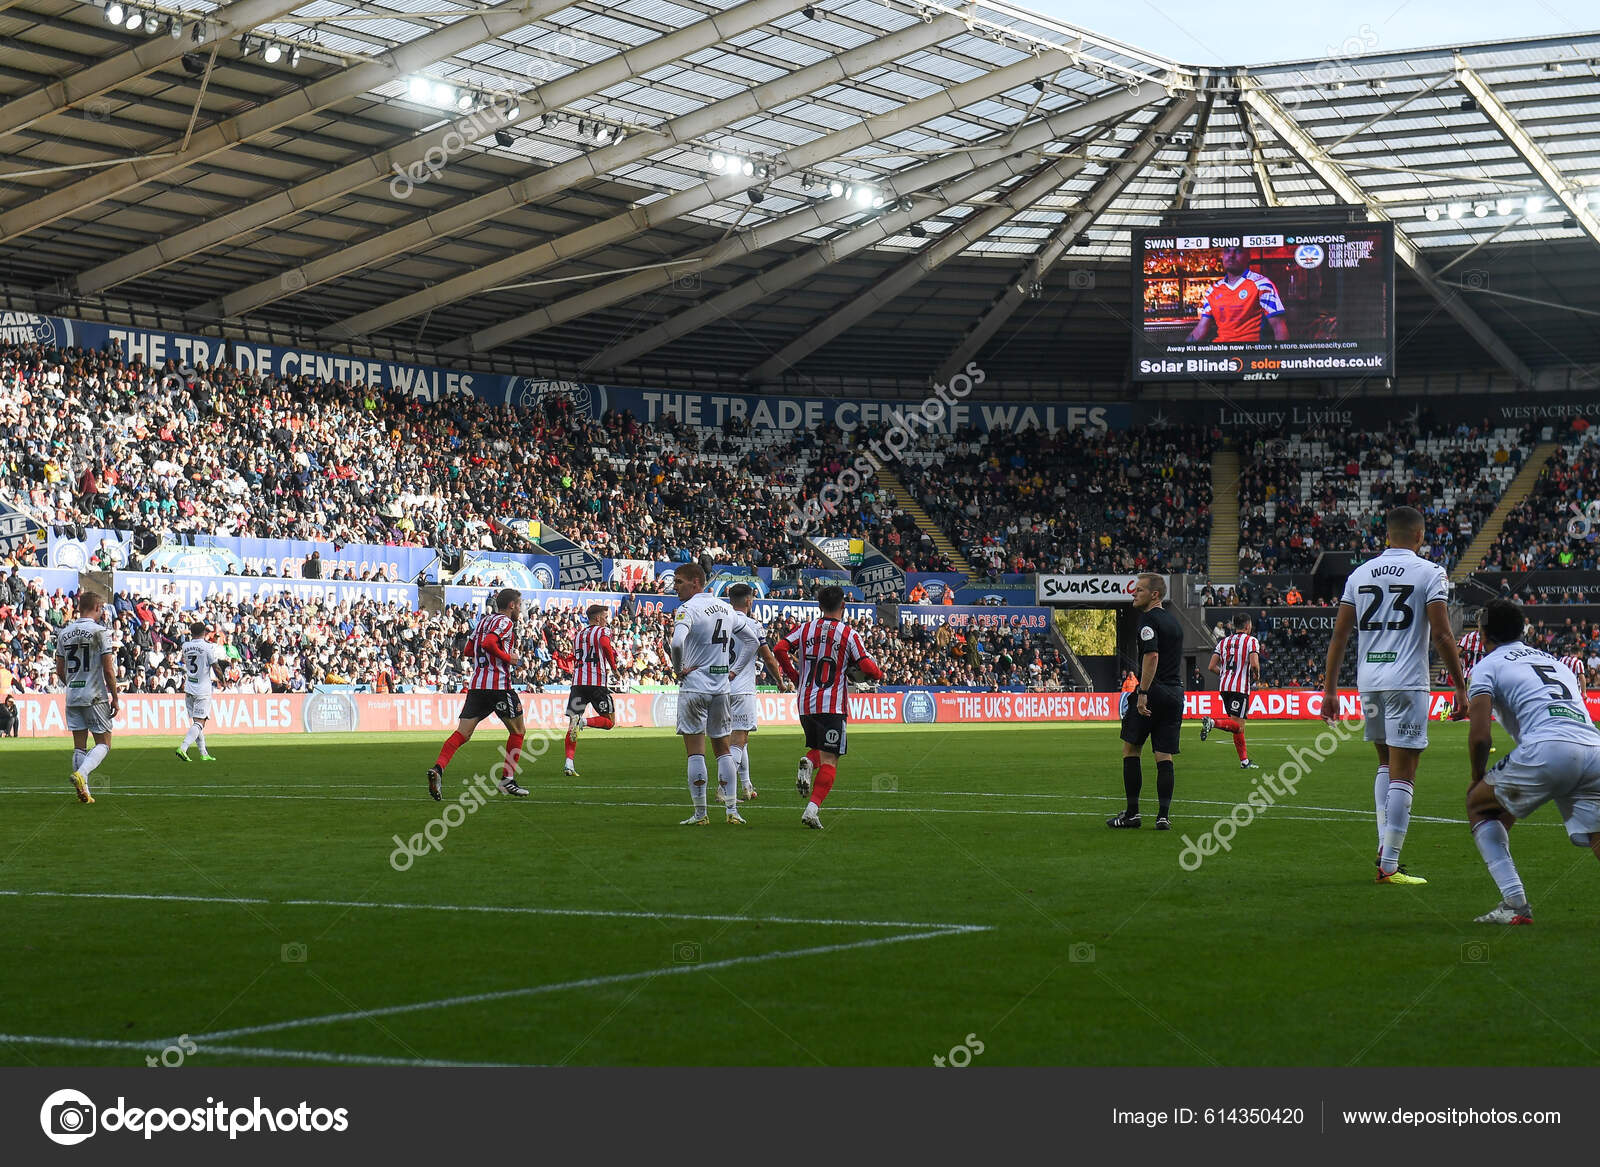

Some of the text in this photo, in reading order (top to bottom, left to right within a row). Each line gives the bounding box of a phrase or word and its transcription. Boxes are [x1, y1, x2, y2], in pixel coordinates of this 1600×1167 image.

[1145, 235, 1277, 249] SWAN 2-0 SUND 50:54
[1296, 235, 1345, 244] DAWSONS
[0, 312, 41, 327] ADE
[1167, 345, 1185, 353] Away
[1197, 344, 1228, 352] available
[1280, 341, 1358, 350] store.swanseacity.com
[109, 329, 166, 371] THE
[280, 352, 381, 391] CENTRE
[389, 365, 474, 402] WALES
[1140, 355, 1382, 374] Solar Blinds solarsunshades.co.uk
[1243, 372, 1279, 381] adi.tv
[531, 380, 580, 394] TRADE
[643, 392, 1108, 435] THE TRADE CENTRE WALES
[1219, 407, 1353, 427] Luxury Living
[560, 552, 585, 567] HE
[560, 565, 602, 584] ADE
[863, 567, 894, 583] THE
[1371, 566, 1405, 578] WOOD
[174, 579, 251, 608] TRADE
[863, 578, 906, 597] RADE
[635, 598, 664, 618] ARS
[704, 604, 729, 617] FULTON
[754, 603, 873, 625] ADE CENTR ALES
[1358, 584, 1415, 631] 23
[921, 614, 945, 626] UK'S
[948, 613, 1007, 627] CHEAPEST
[1011, 615, 1047, 628] CARS
[1271, 617, 1338, 631] ESTACRE
[712, 619, 728, 652] 4
[64, 643, 90, 673] 31
[187, 655, 198, 674] 3
[805, 654, 838, 689] 10
[1531, 665, 1572, 700] 5
[17, 697, 292, 731] TRA CENTR WALES
[393, 698, 432, 726] THE
[438, 698, 464, 725] UK
[614, 698, 637, 724] RS
[757, 697, 783, 721] ADE
[849, 697, 897, 720] WALES
[941, 696, 1110, 718] Probably THE UK'S CHEAPEST CARS
[1183, 694, 1211, 715] HE
[1219, 694, 1299, 715] TADE
[1397, 729, 1422, 737] HOUSE
